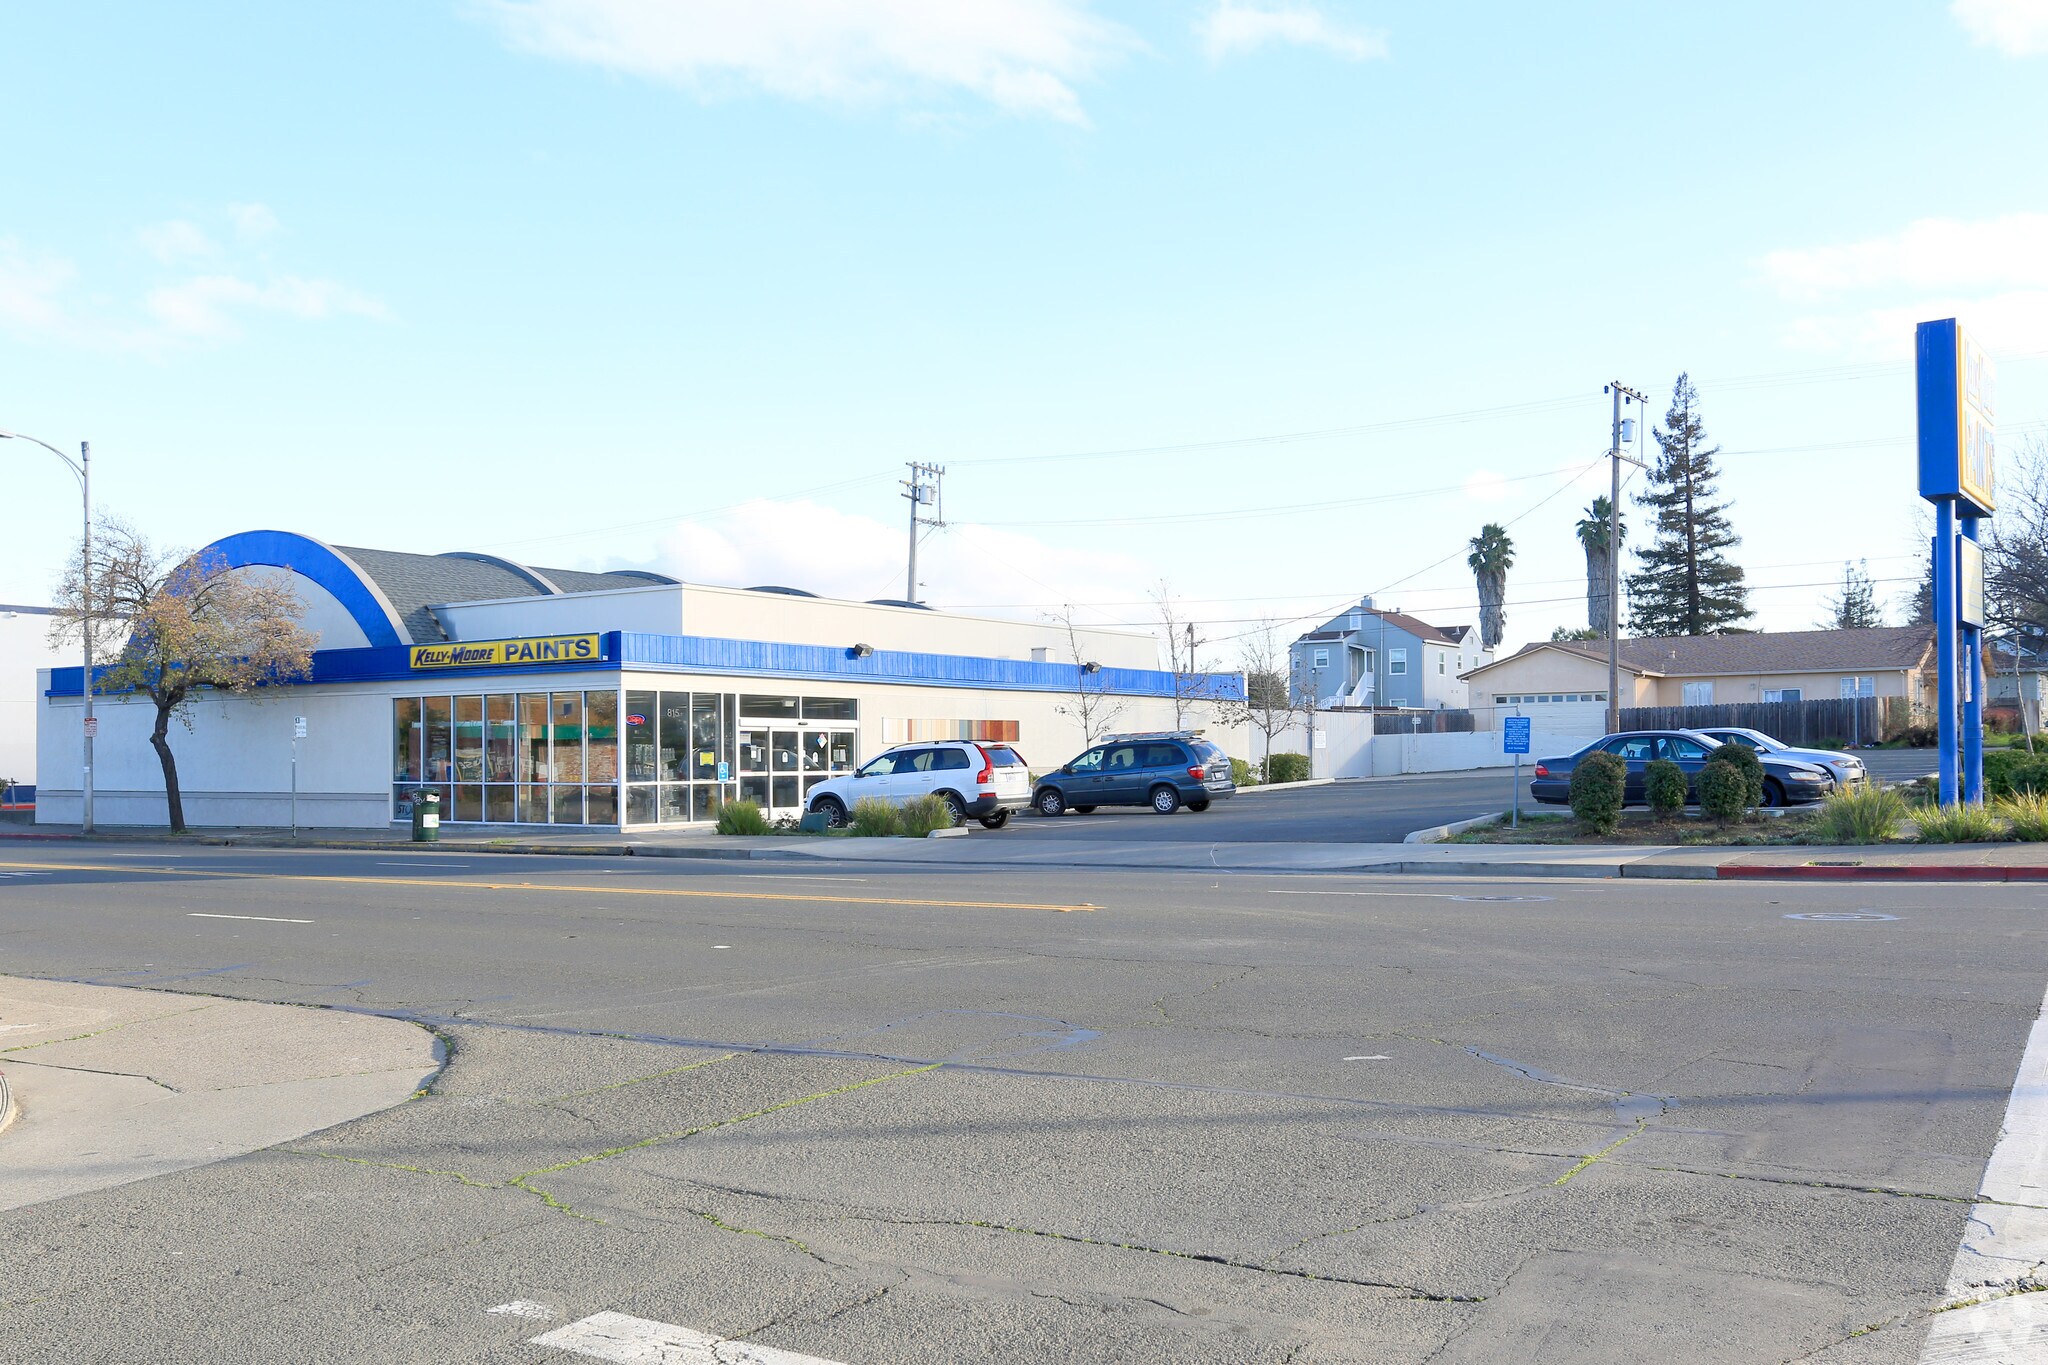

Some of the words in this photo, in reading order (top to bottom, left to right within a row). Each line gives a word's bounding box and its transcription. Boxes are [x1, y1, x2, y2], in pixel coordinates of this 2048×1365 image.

[414, 646, 495, 666] KELLY-MOORE
[505, 638, 591, 661] PAINTS
[667, 708, 680, 718] 815
